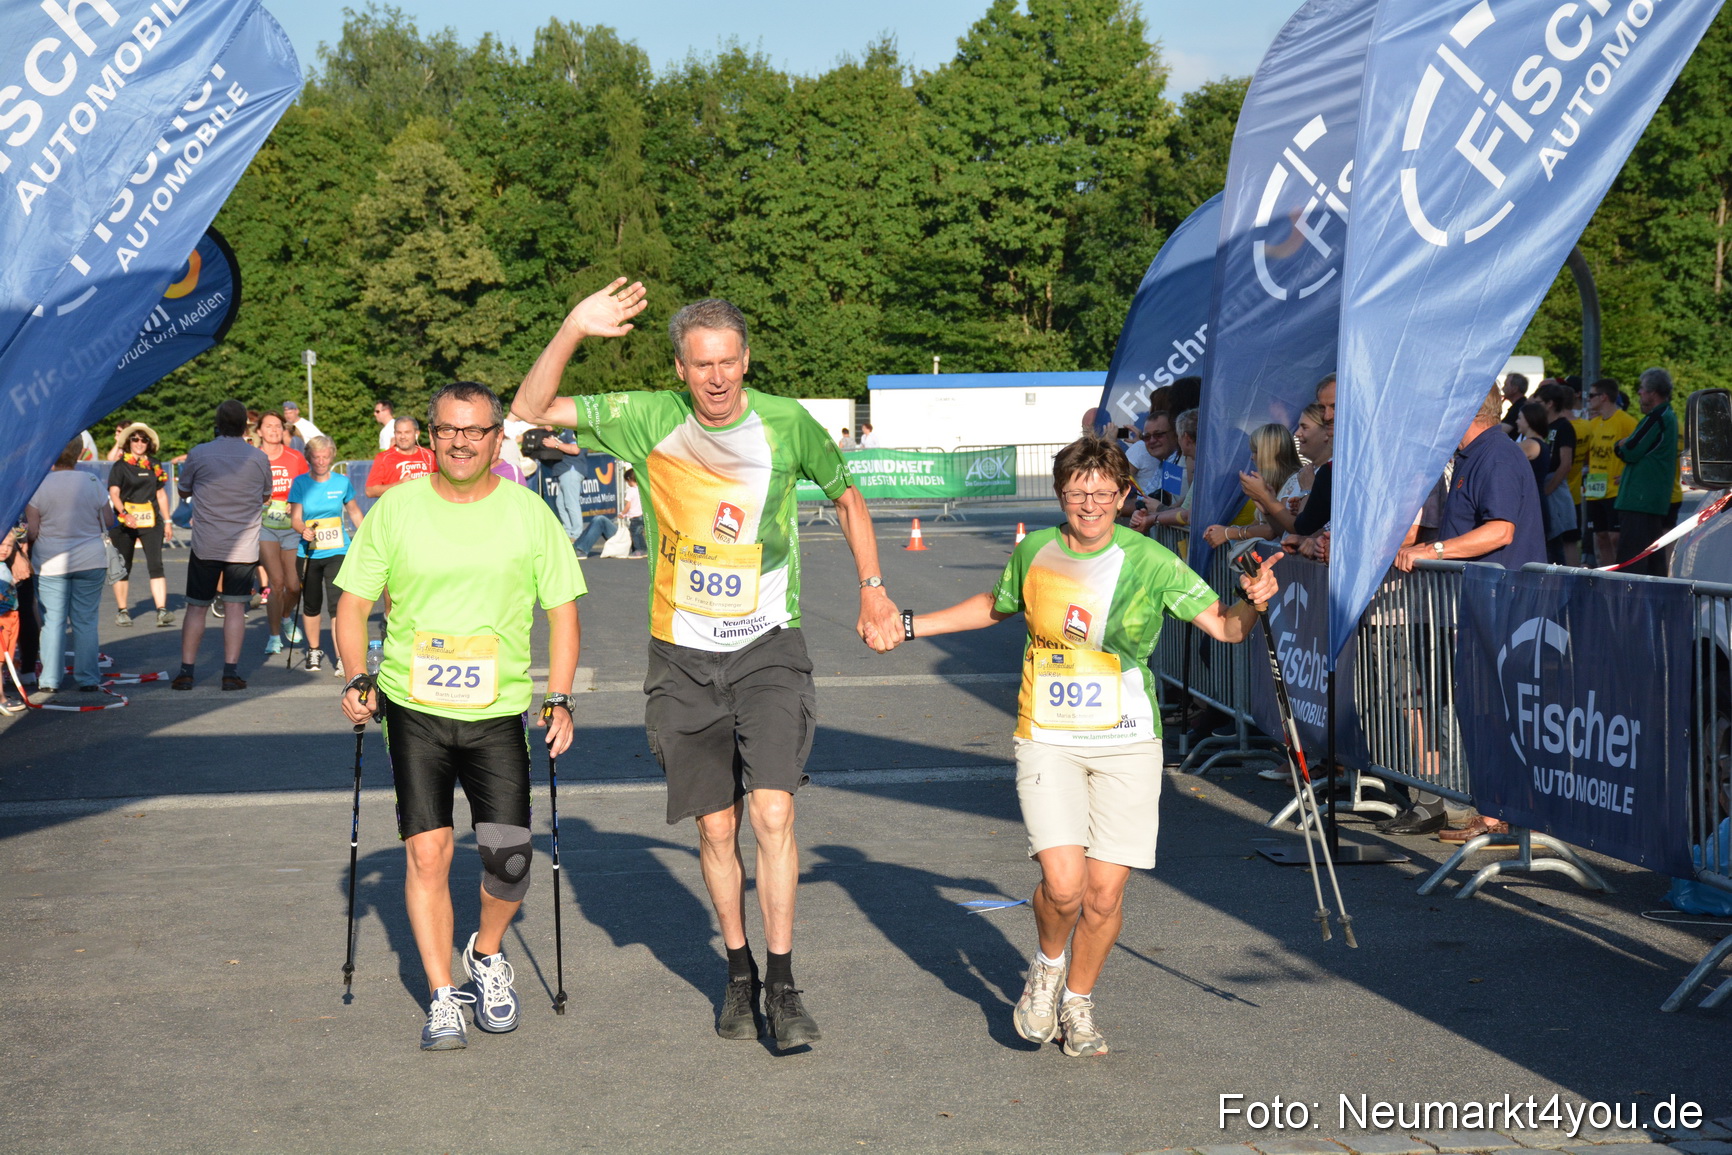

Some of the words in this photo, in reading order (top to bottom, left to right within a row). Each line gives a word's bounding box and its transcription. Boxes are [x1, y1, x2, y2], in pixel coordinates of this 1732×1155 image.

[1455, 0, 1612, 189] Fisc
[116, 81, 249, 273] AUTOMOBILE
[178, 291, 226, 331] Medien
[847, 459, 935, 475] GESUNDHEIT
[860, 476, 867, 486] IN
[868, 474, 897, 486] BESTEN
[900, 473, 945, 486] HÄNDEN
[965, 455, 1011, 480] AOK
[317, 529, 338, 540] 089
[716, 533, 732, 544] 1628
[689, 569, 742, 597] 989
[904, 615, 912, 637] LEKI
[1277, 631, 1328, 694] Fische
[427, 664, 481, 688] 225
[1049, 681, 1102, 707] 992
[1517, 682, 1641, 770] Fischer
[1533, 765, 1635, 815] AUTOMOBILE
